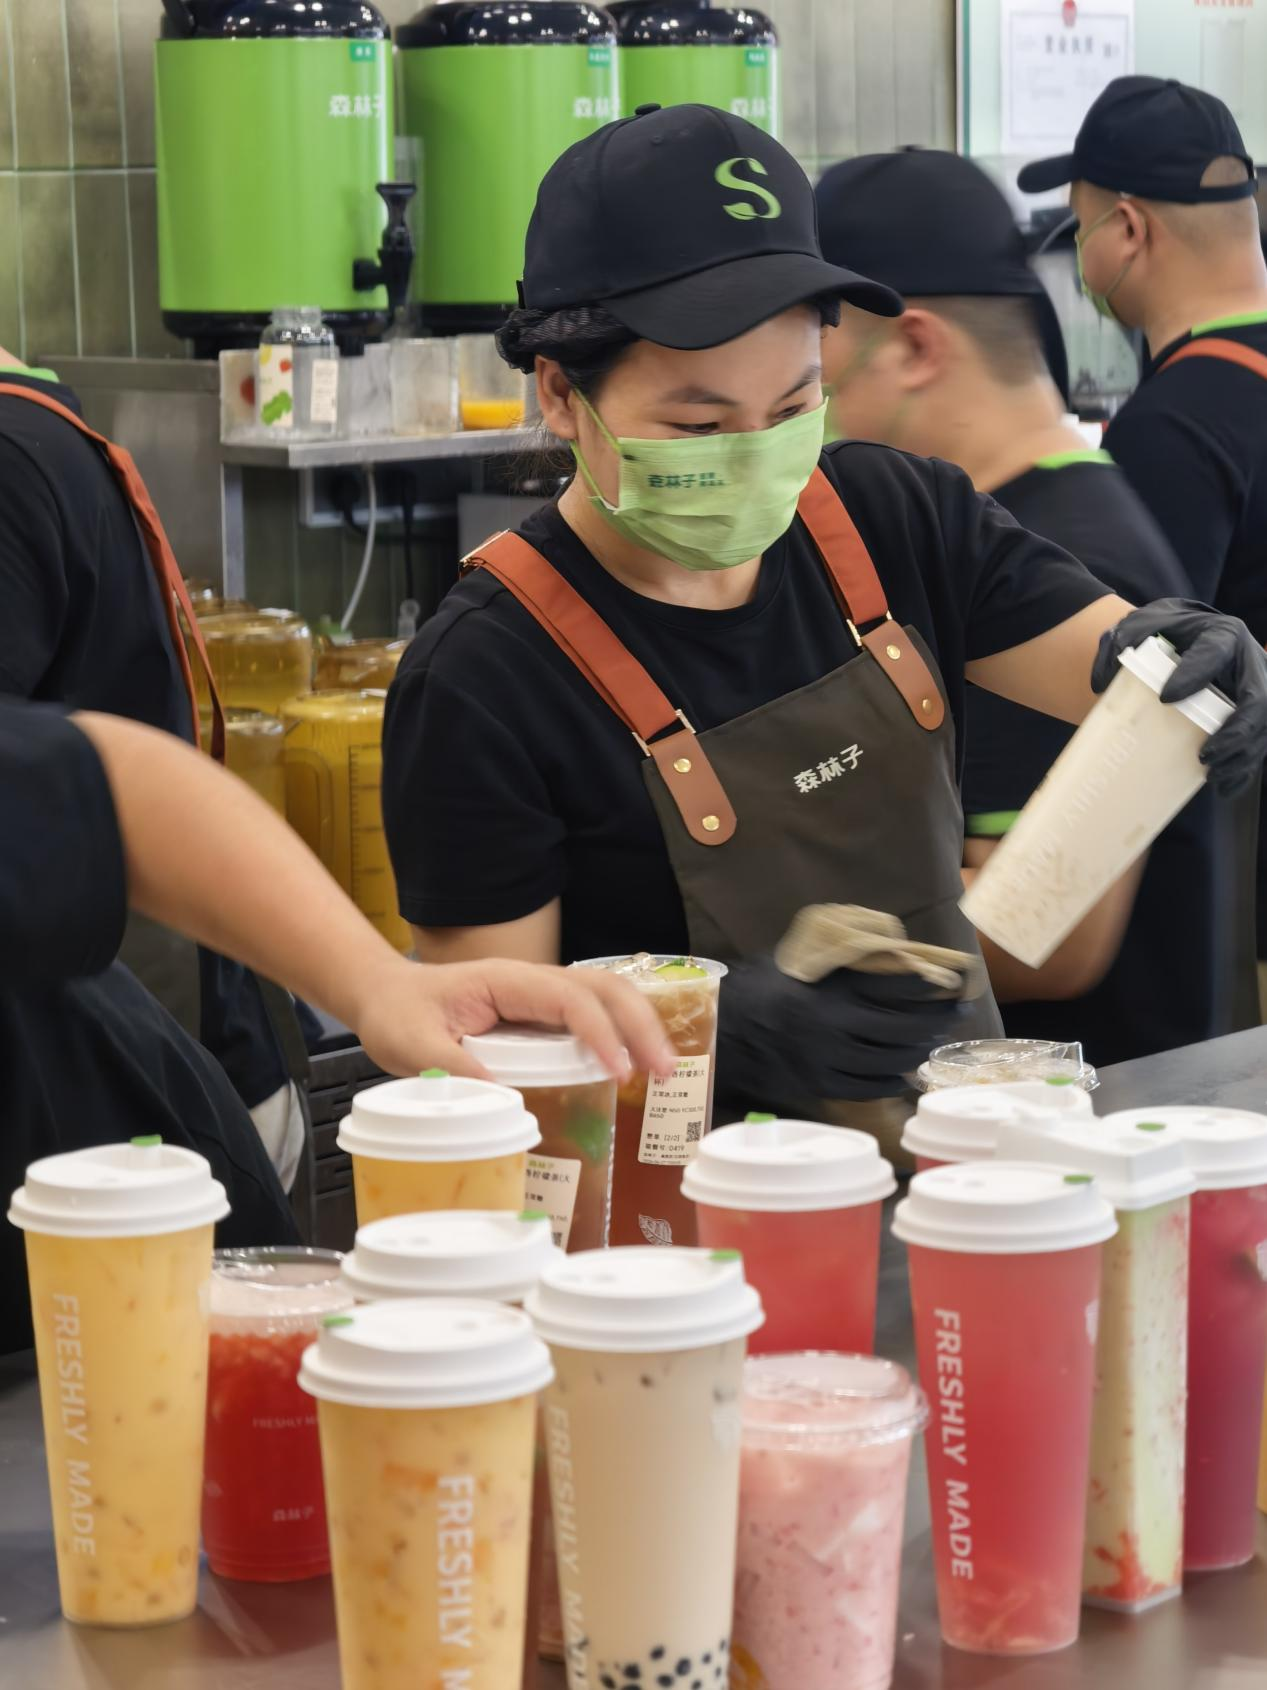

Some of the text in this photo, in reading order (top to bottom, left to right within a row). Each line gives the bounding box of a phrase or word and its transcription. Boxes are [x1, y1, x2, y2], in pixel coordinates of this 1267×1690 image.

[793, 744, 863, 793] 森林子
[53, 1292, 96, 1556] FRESHLY MADE
[934, 1307, 974, 1580] FRESHLY MADE
[437, 1475, 475, 1649] FRESHLY
